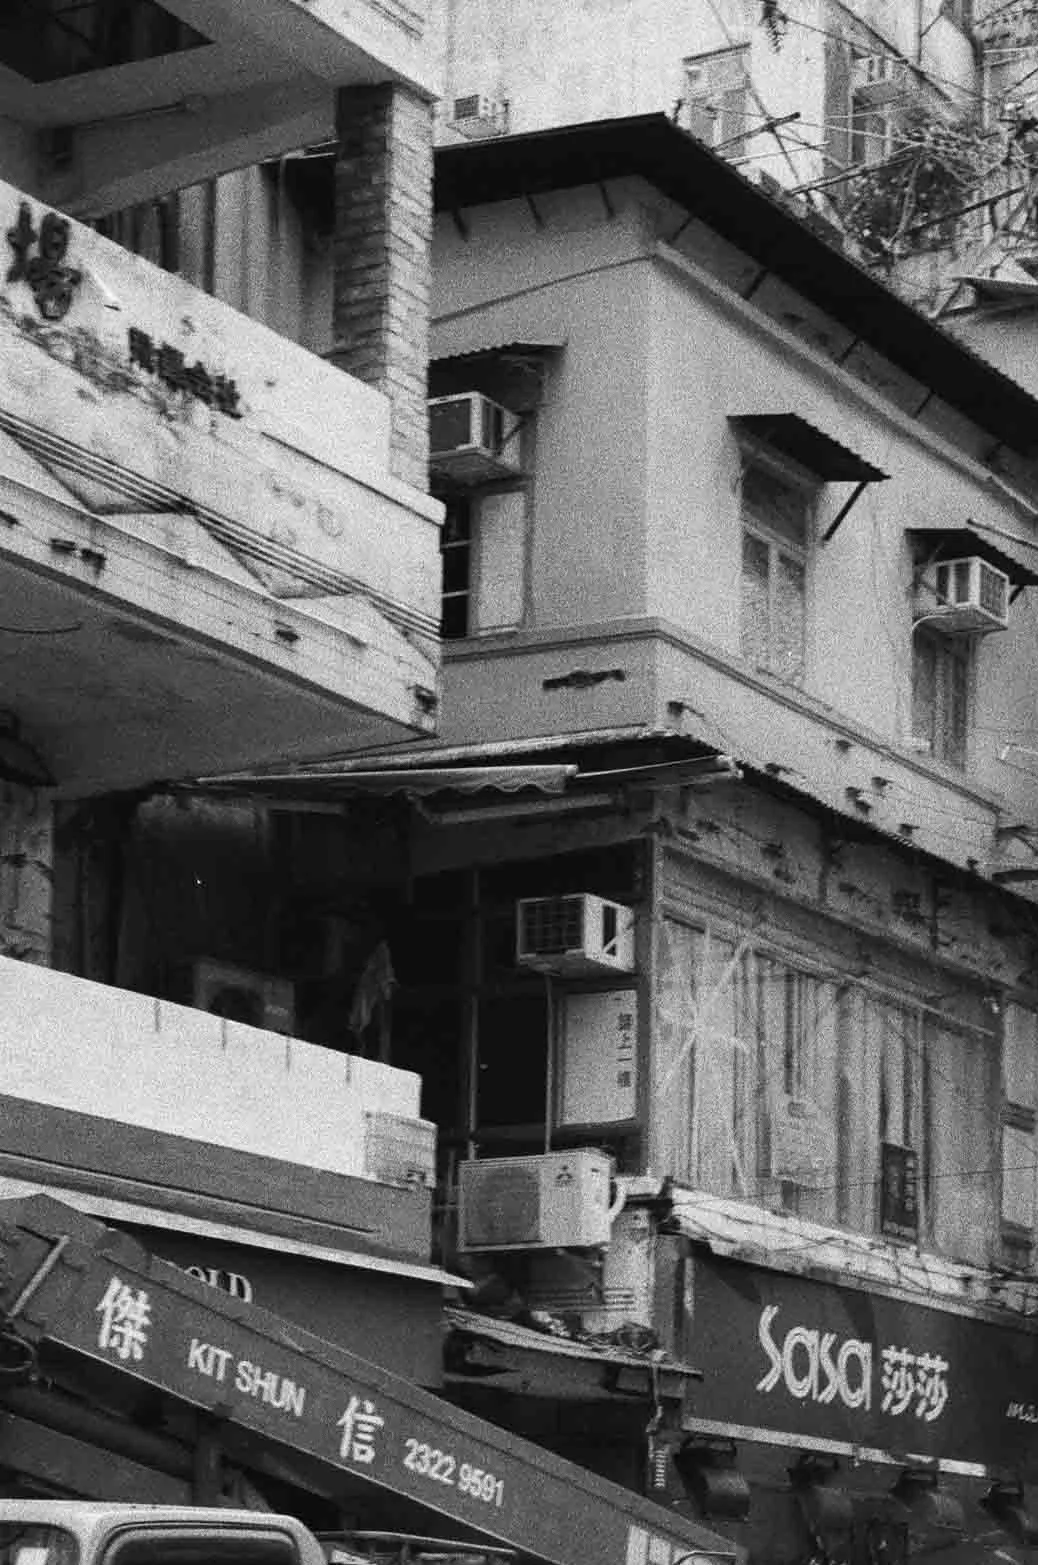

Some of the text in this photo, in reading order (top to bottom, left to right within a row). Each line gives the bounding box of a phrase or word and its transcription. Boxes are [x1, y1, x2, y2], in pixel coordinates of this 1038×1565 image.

[187, 1337, 234, 1382] KIT
[235, 1359, 306, 1419] SHUN
[335, 1394, 385, 1465] 信
[402, 1437, 456, 1487] 2322
[459, 1463, 507, 1508] 9591
[881, 1343, 950, 1424] 莎莎
